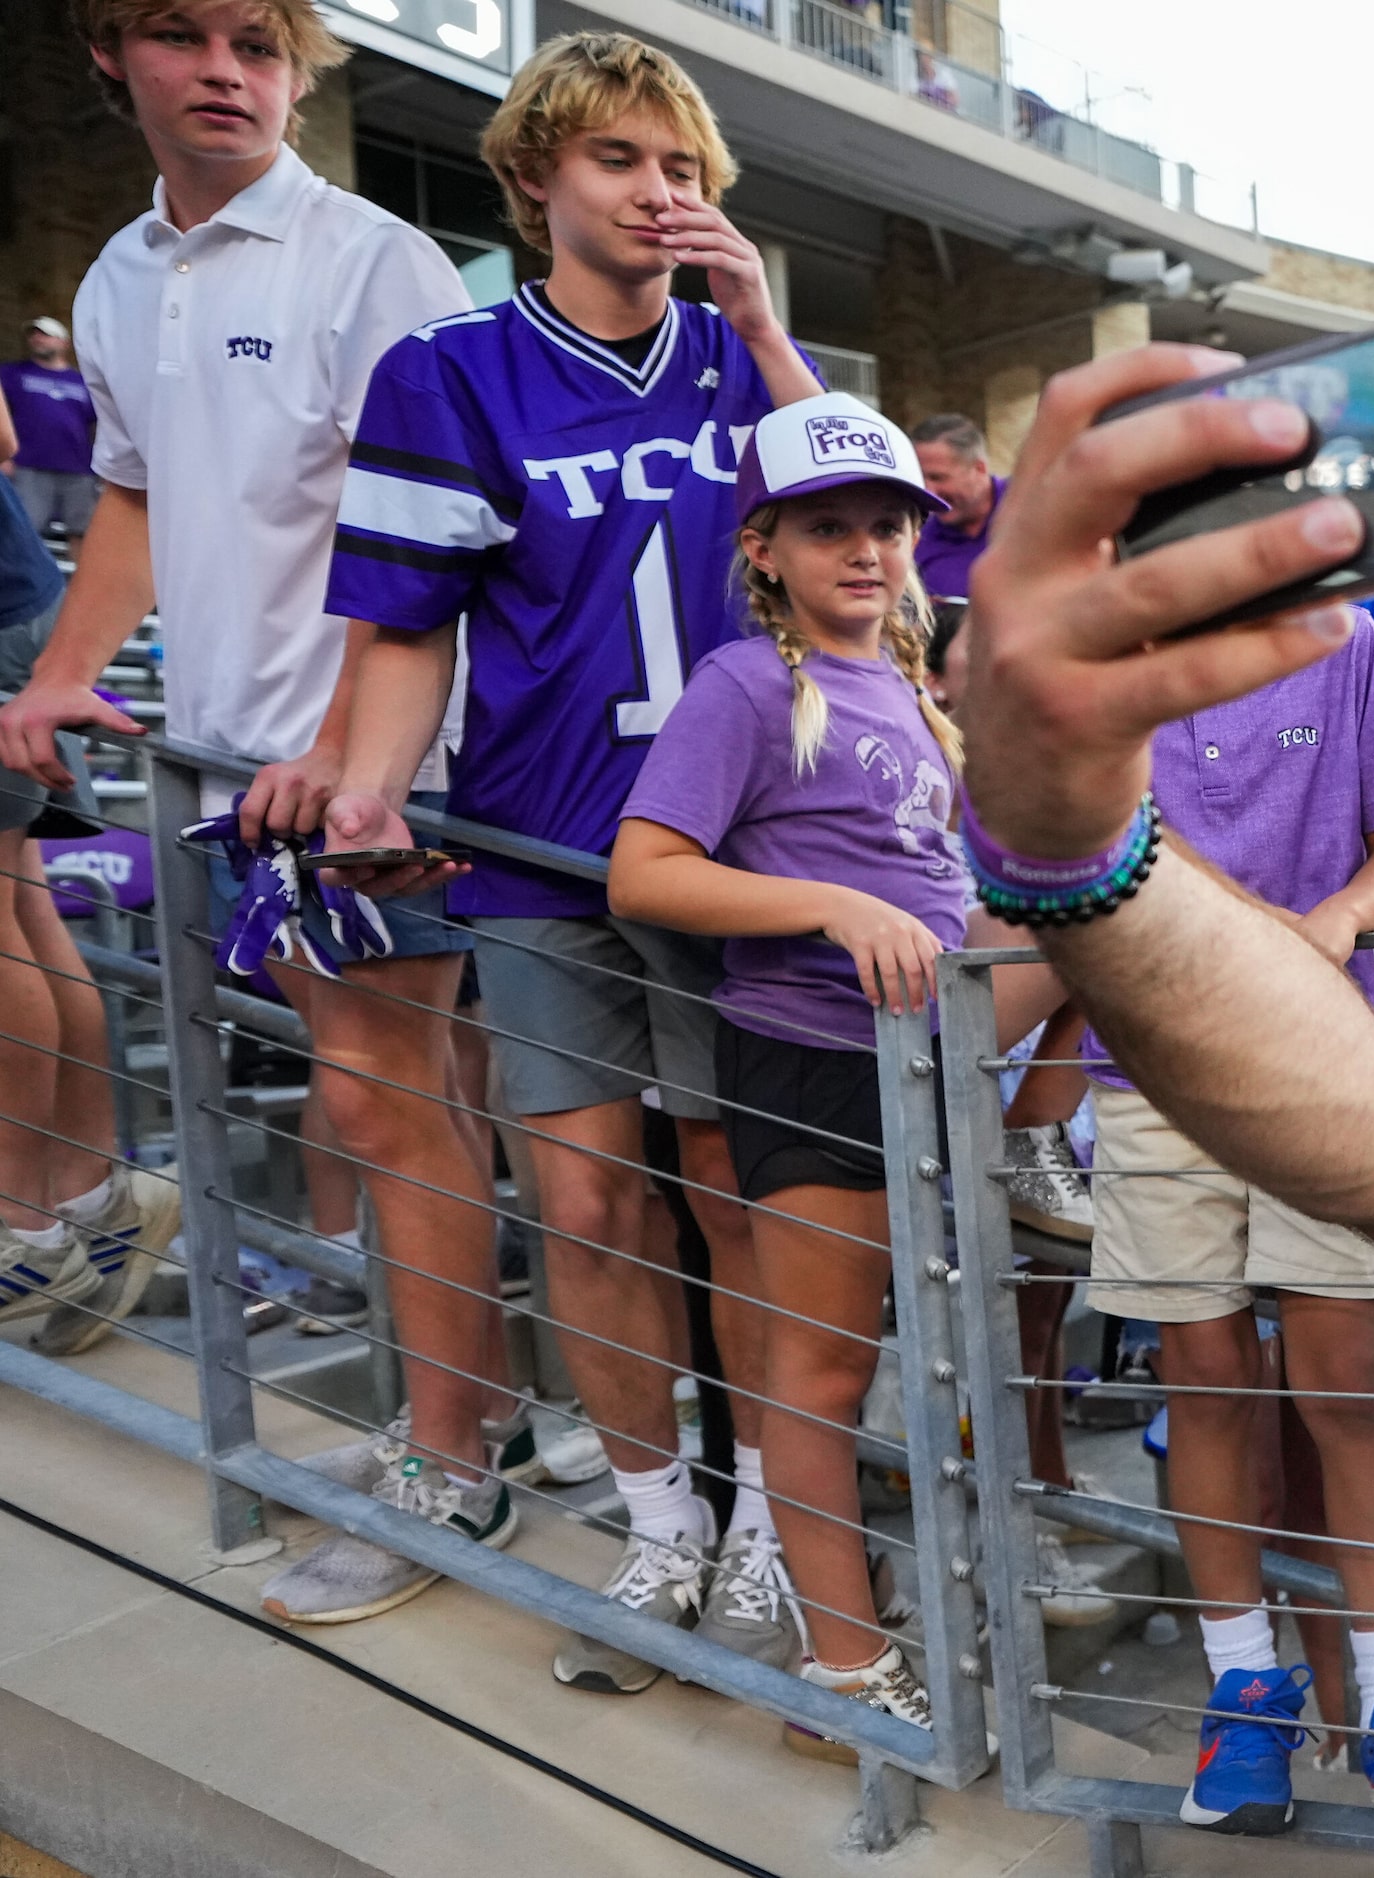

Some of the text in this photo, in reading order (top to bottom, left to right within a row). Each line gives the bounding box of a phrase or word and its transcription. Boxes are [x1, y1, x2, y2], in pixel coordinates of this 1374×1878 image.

[226, 336, 273, 361] TCU
[815, 429, 888, 455] Frog
[522, 420, 755, 519] TCU
[607, 512, 689, 743] 1
[1277, 726, 1317, 749] TCU
